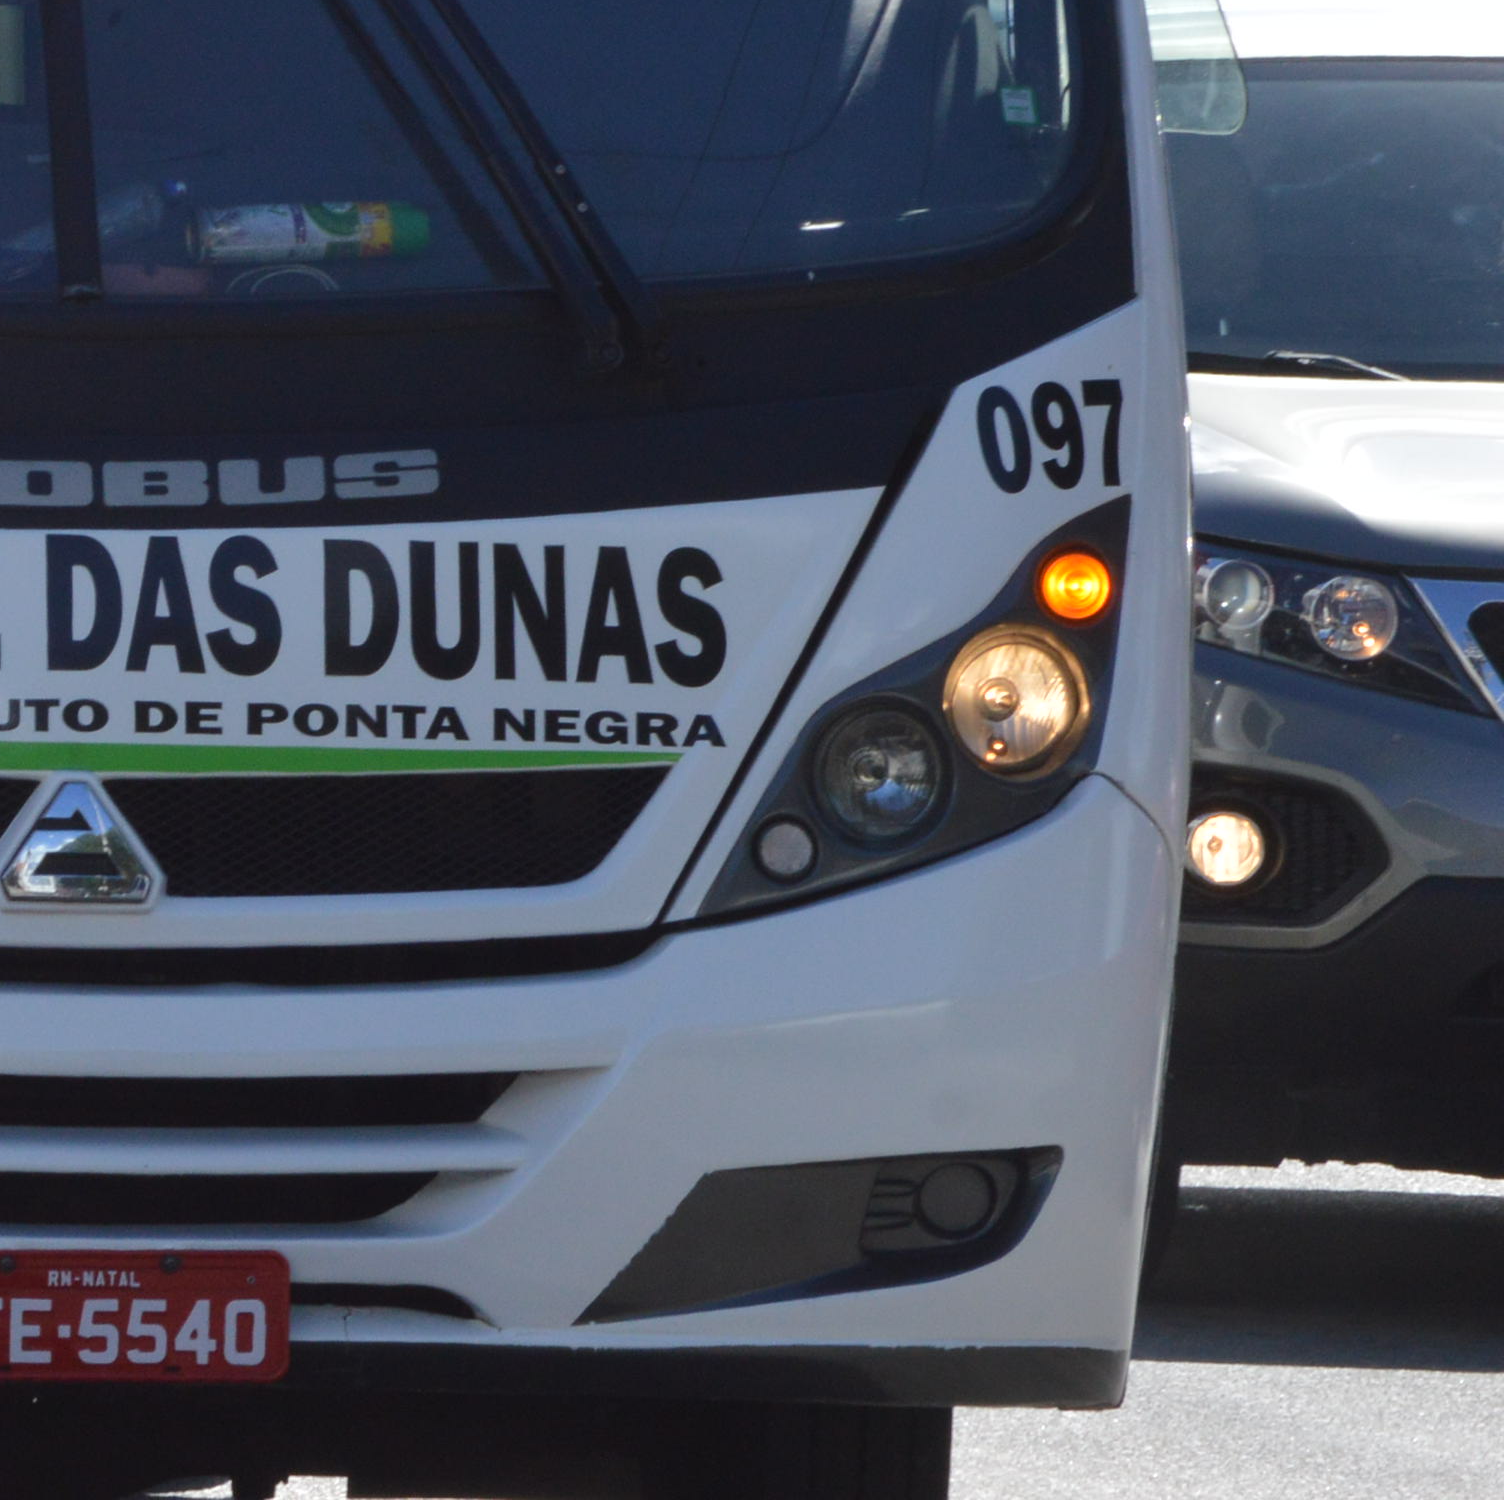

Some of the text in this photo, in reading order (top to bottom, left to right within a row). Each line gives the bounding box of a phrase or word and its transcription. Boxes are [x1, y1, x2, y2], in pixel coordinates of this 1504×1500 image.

[977, 379, 1122, 494] 097
[45, 533, 282, 675] DAS
[323, 539, 727, 688] DUNAS
[134, 700, 223, 736] DE
[247, 702, 470, 742] PONTA
[494, 707, 727, 748] NEGRA
[47, 1269, 140, 1288] RN-NATAL
